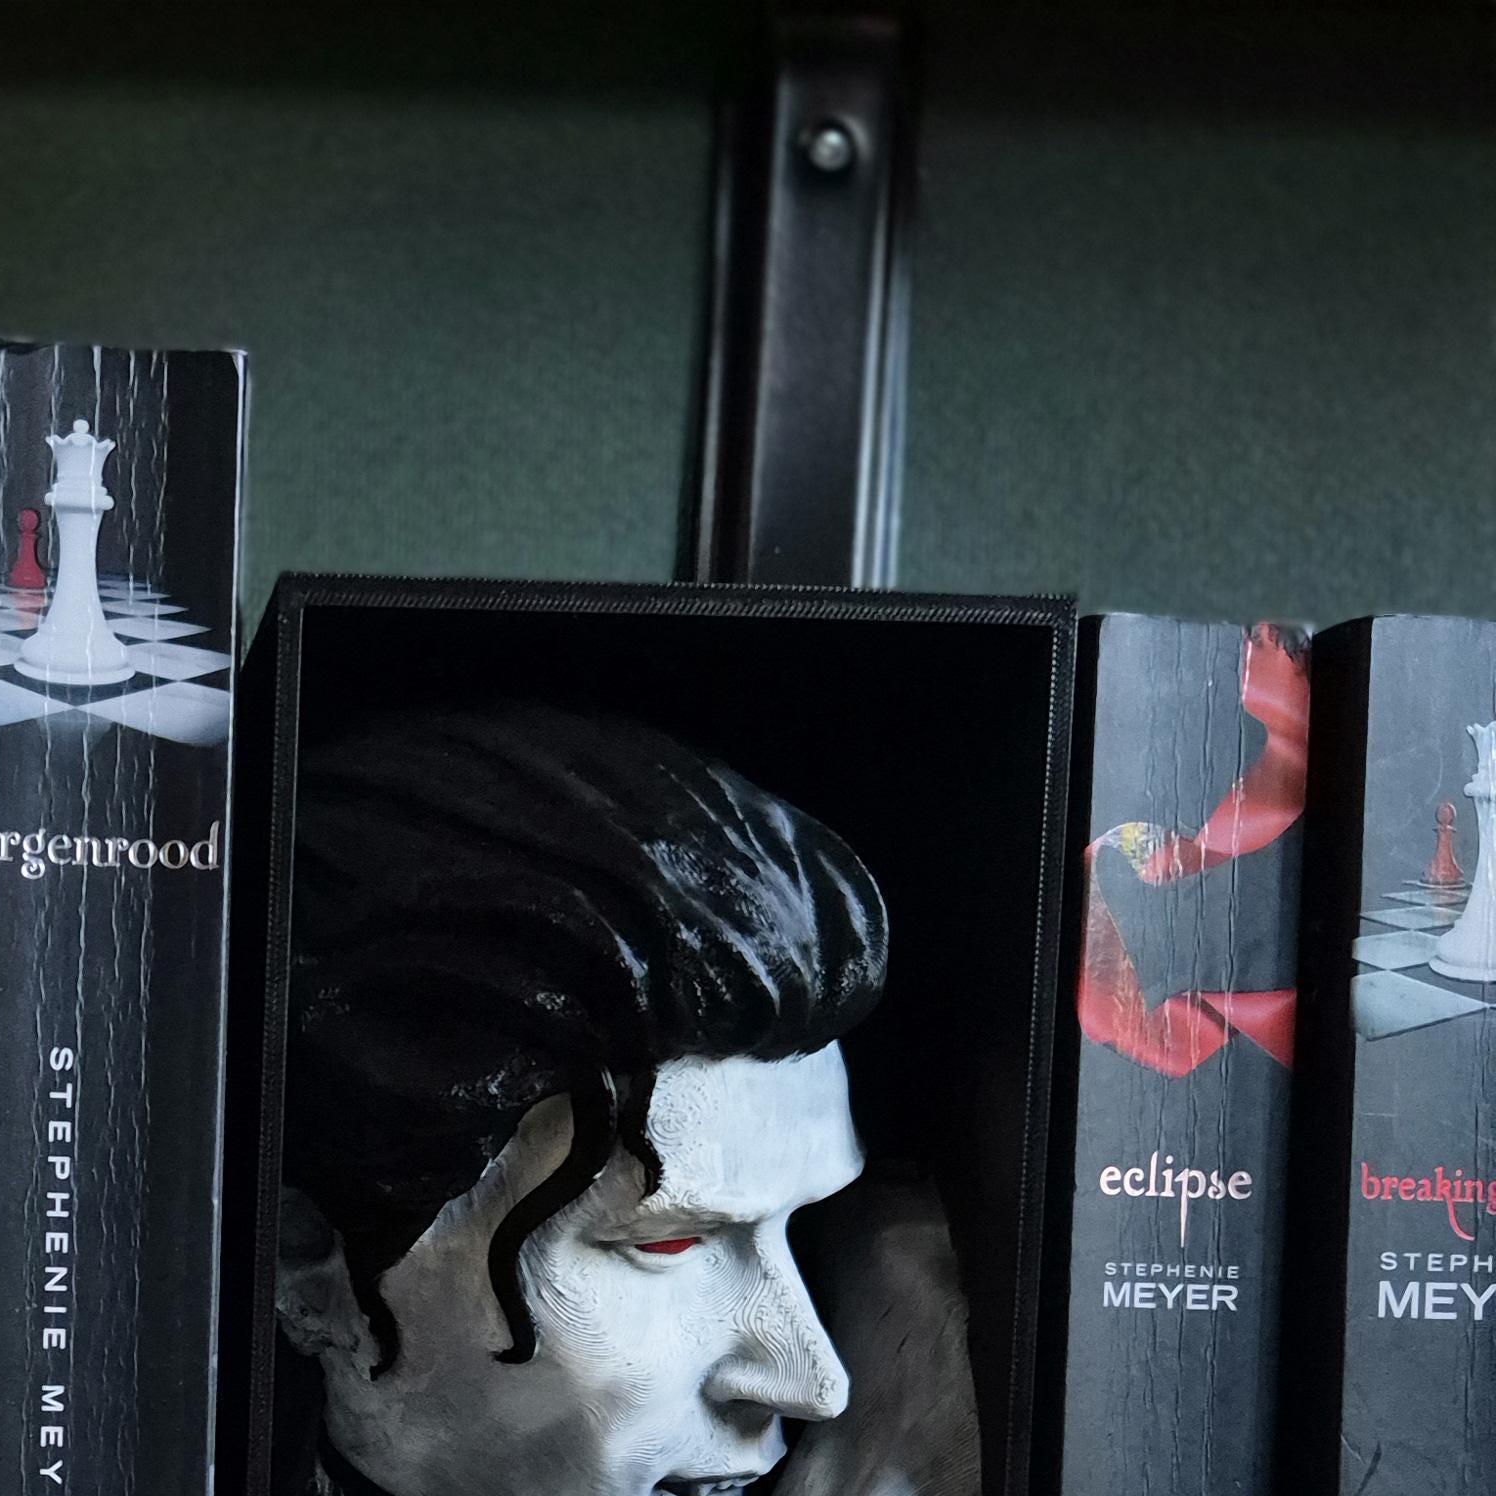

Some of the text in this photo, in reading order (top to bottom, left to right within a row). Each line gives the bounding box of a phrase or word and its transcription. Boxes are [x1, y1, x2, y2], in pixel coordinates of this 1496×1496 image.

[42, 1046, 75, 1351] STEPHENIE
[1099, 1150, 1253, 1248] eclipse
[1103, 1281, 1240, 1312] MEYER
[1104, 1262, 1240, 1280] STEPHENIE
